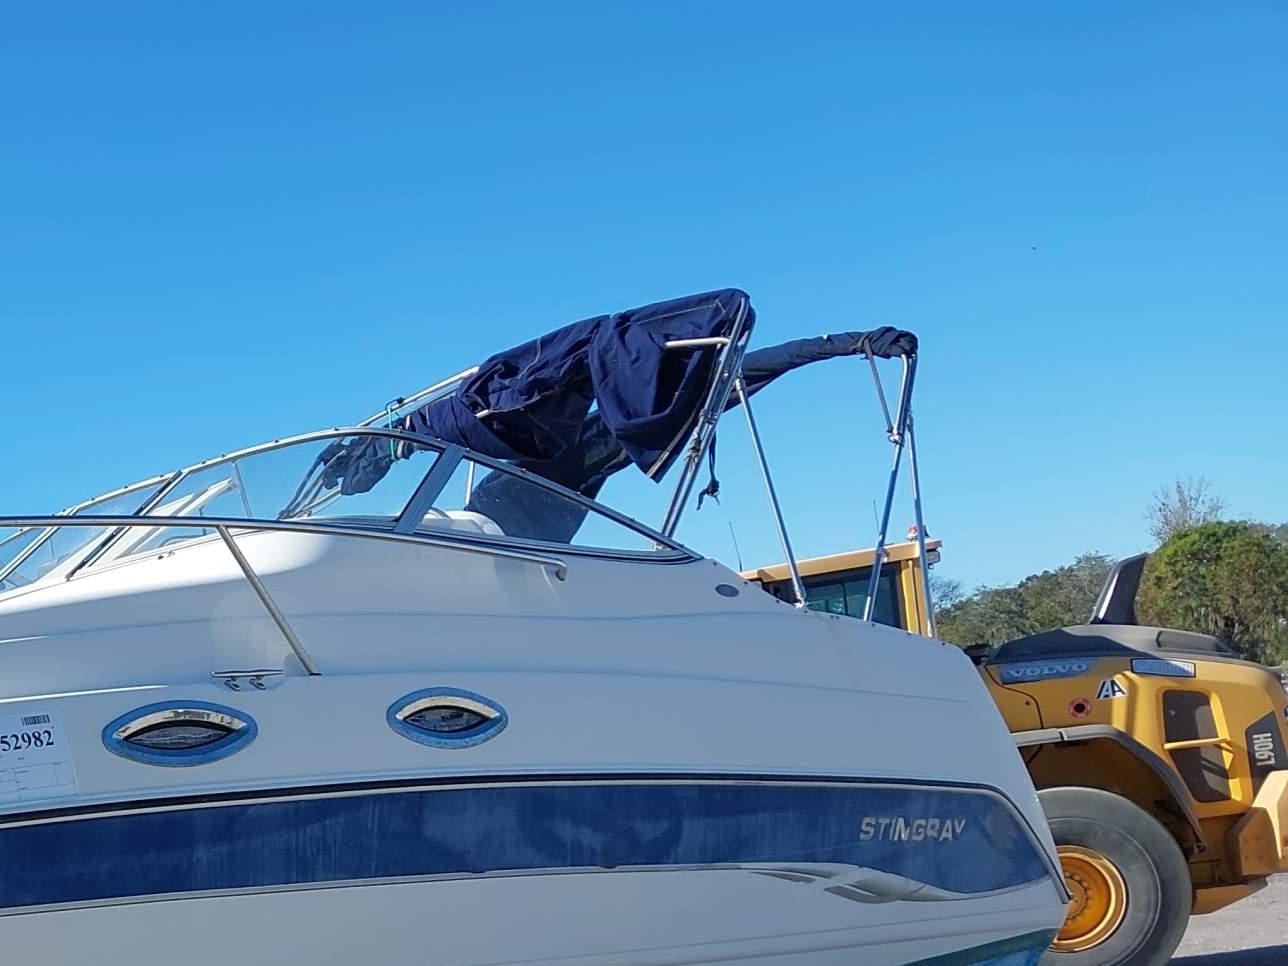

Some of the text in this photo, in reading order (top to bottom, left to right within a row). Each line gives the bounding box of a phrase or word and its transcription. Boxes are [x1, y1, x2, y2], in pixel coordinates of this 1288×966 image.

[1008, 663, 1088, 677] VOLVO
[1252, 732, 1276, 766] L90H
[859, 816, 967, 842] STINGRAY
